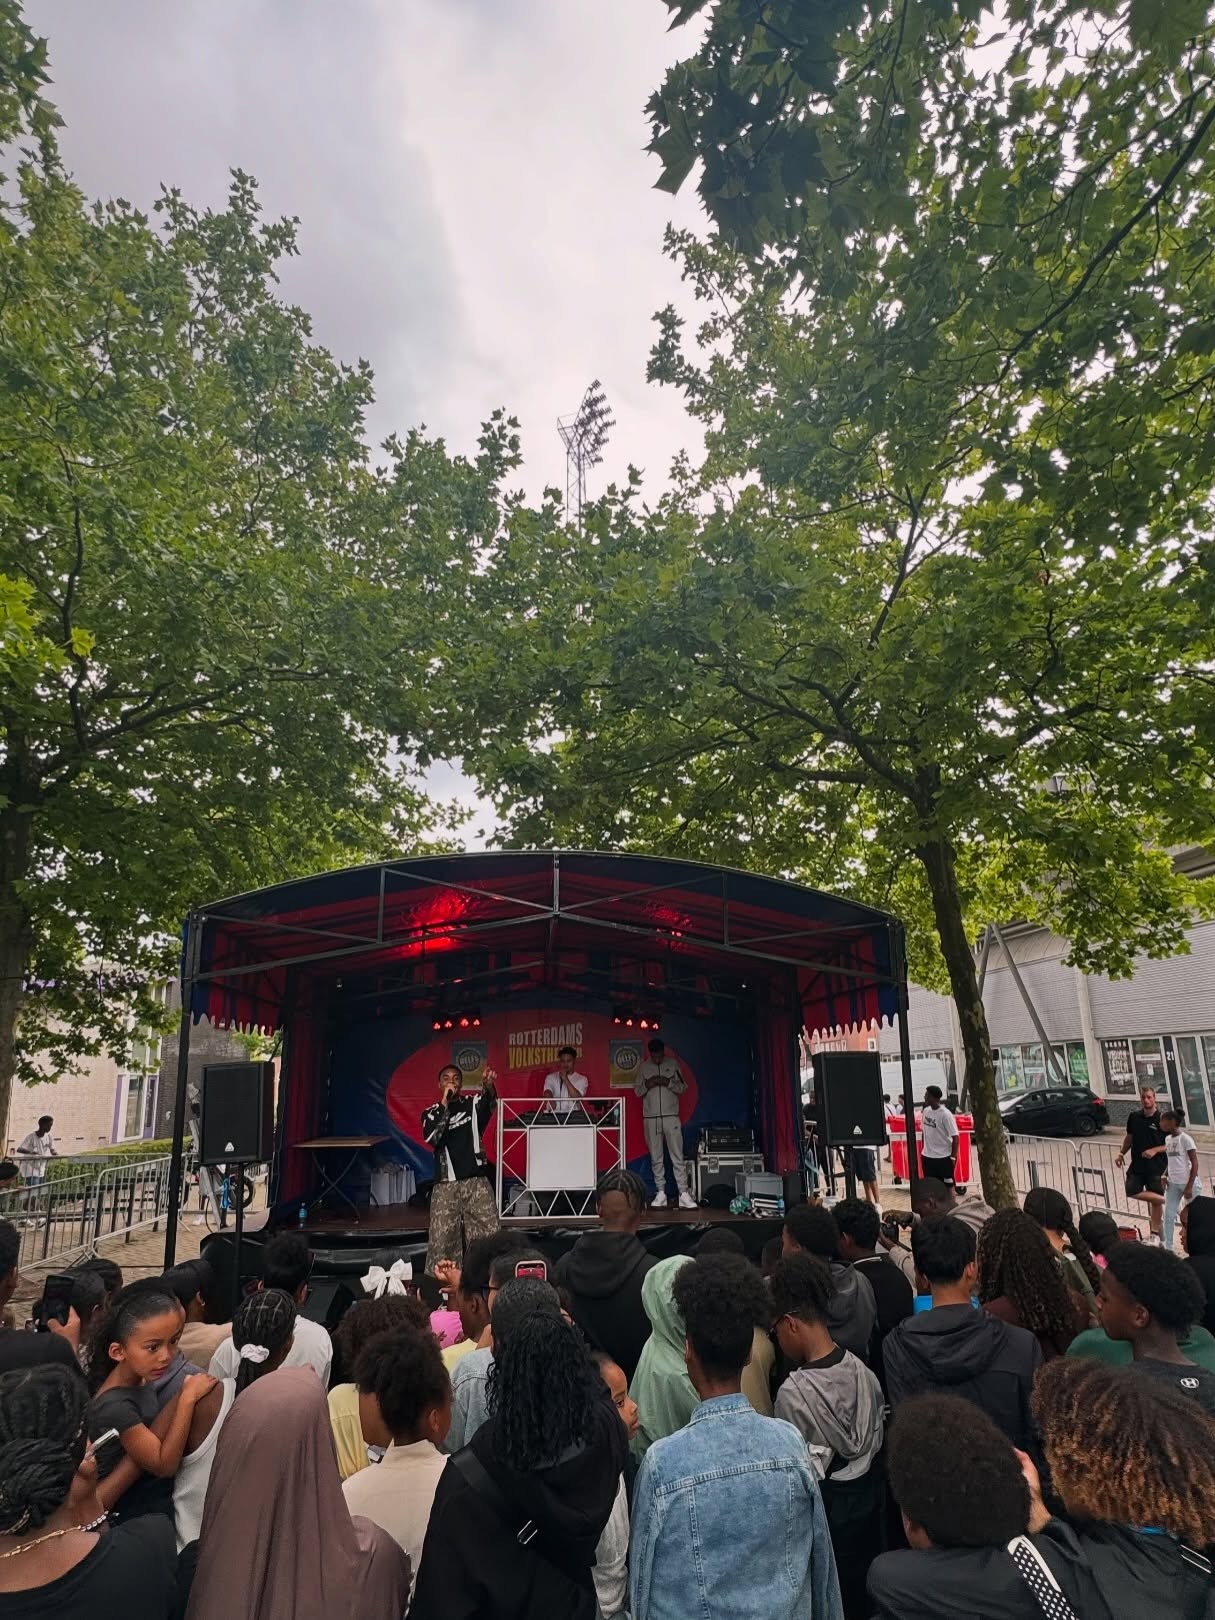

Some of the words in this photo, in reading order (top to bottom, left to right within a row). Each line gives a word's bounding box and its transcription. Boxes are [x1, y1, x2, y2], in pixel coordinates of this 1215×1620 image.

[509, 1022, 583, 1045] ROTTERDAMS
[509, 1047, 583, 1069] VOLKSTHER
[1166, 1051, 1175, 1061] 21
